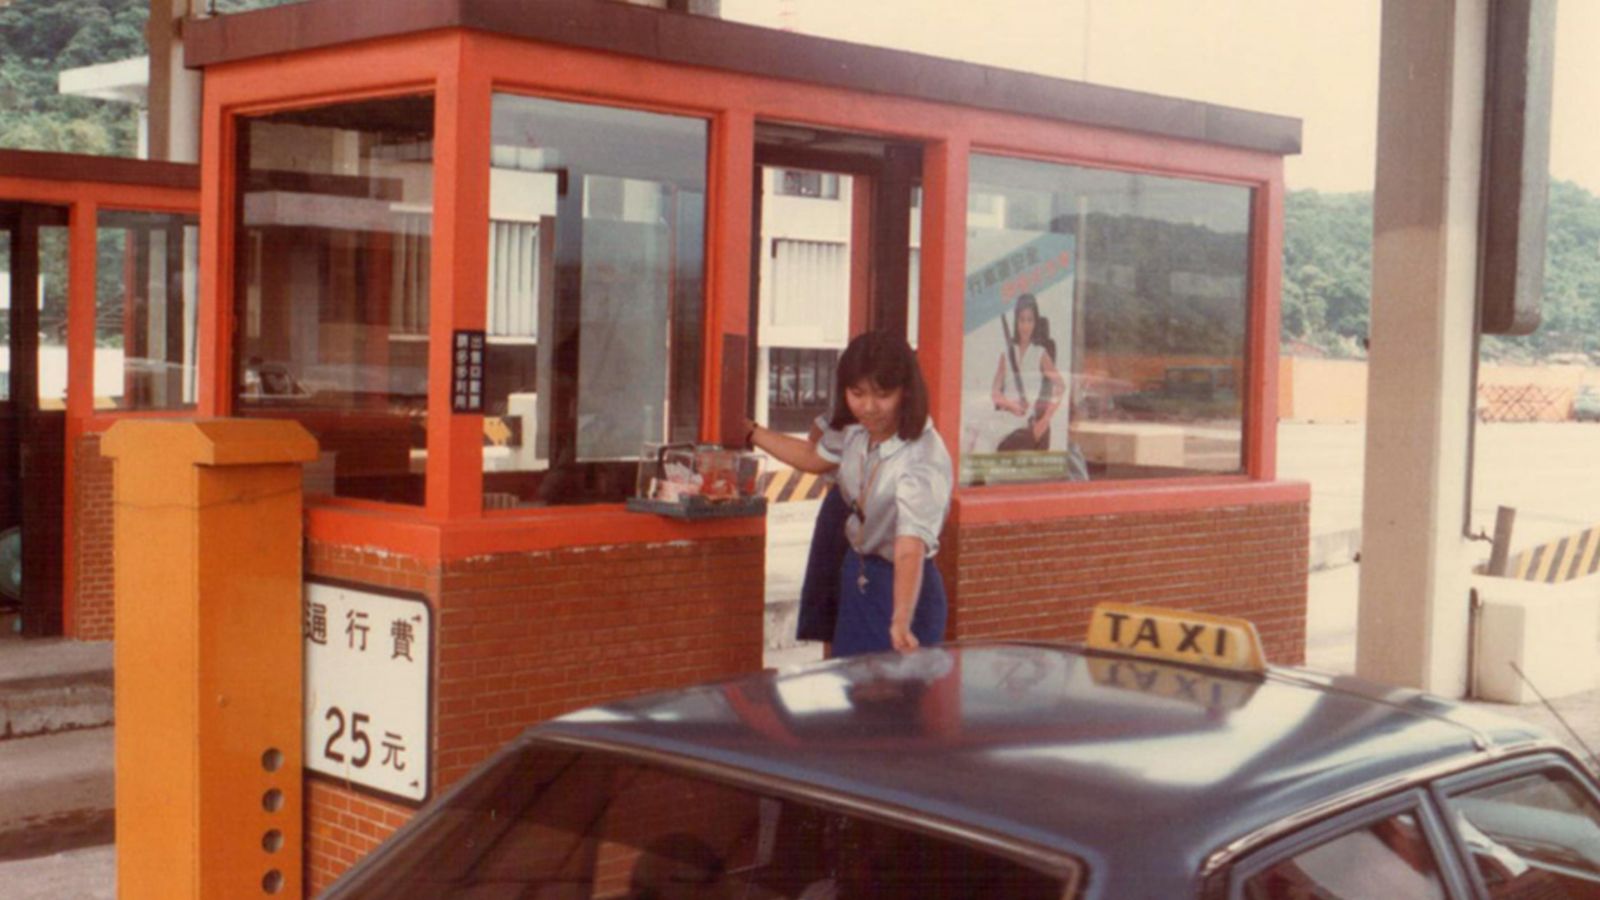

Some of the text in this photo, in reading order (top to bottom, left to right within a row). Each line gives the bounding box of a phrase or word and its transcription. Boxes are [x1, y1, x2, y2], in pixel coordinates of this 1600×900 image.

[306, 602, 414, 662] 通行費
[1104, 612, 1227, 656] TAXI
